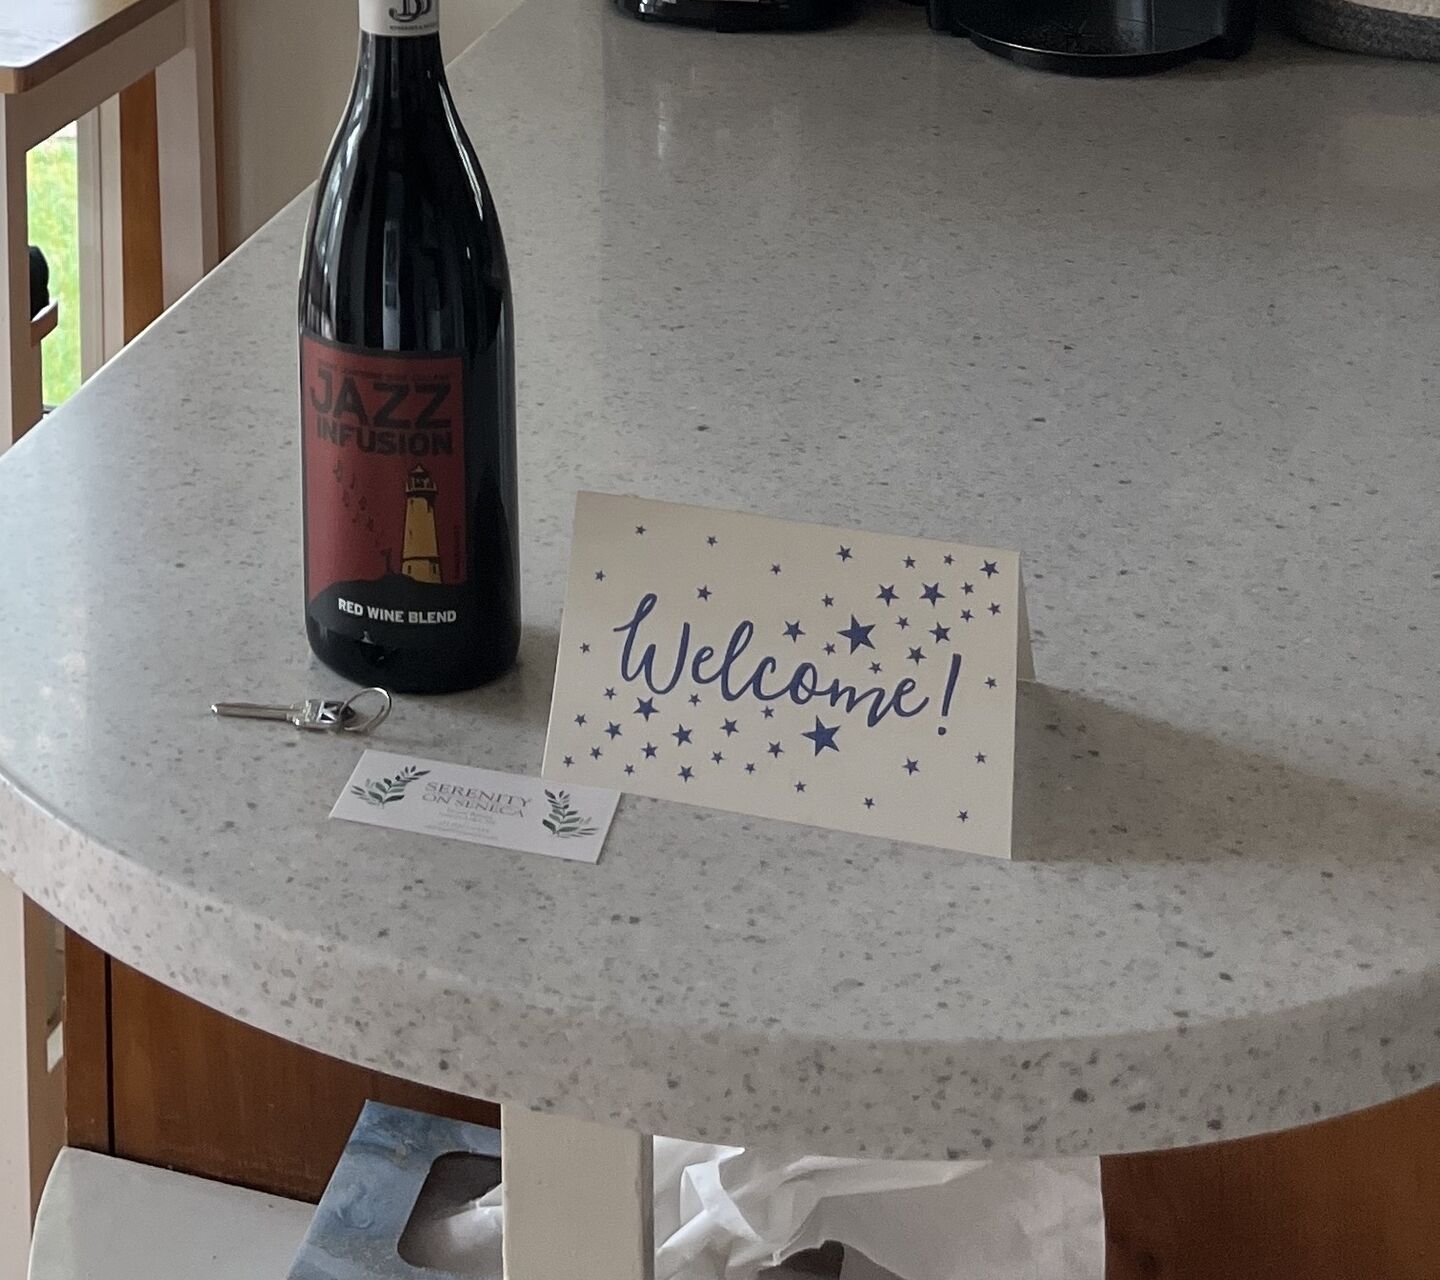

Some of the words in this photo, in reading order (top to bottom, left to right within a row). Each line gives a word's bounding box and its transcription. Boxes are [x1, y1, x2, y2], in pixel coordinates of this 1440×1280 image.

[311, 367, 452, 429] JAZZ
[316, 414, 453, 456] INFUSION
[337, 597, 364, 616] RED
[367, 605, 404, 623] WINE
[408, 609, 457, 624] BLEND
[613, 593, 963, 736] Welcome!
[421, 793, 452, 805] ON
[425, 781, 532, 808] SERENITY
